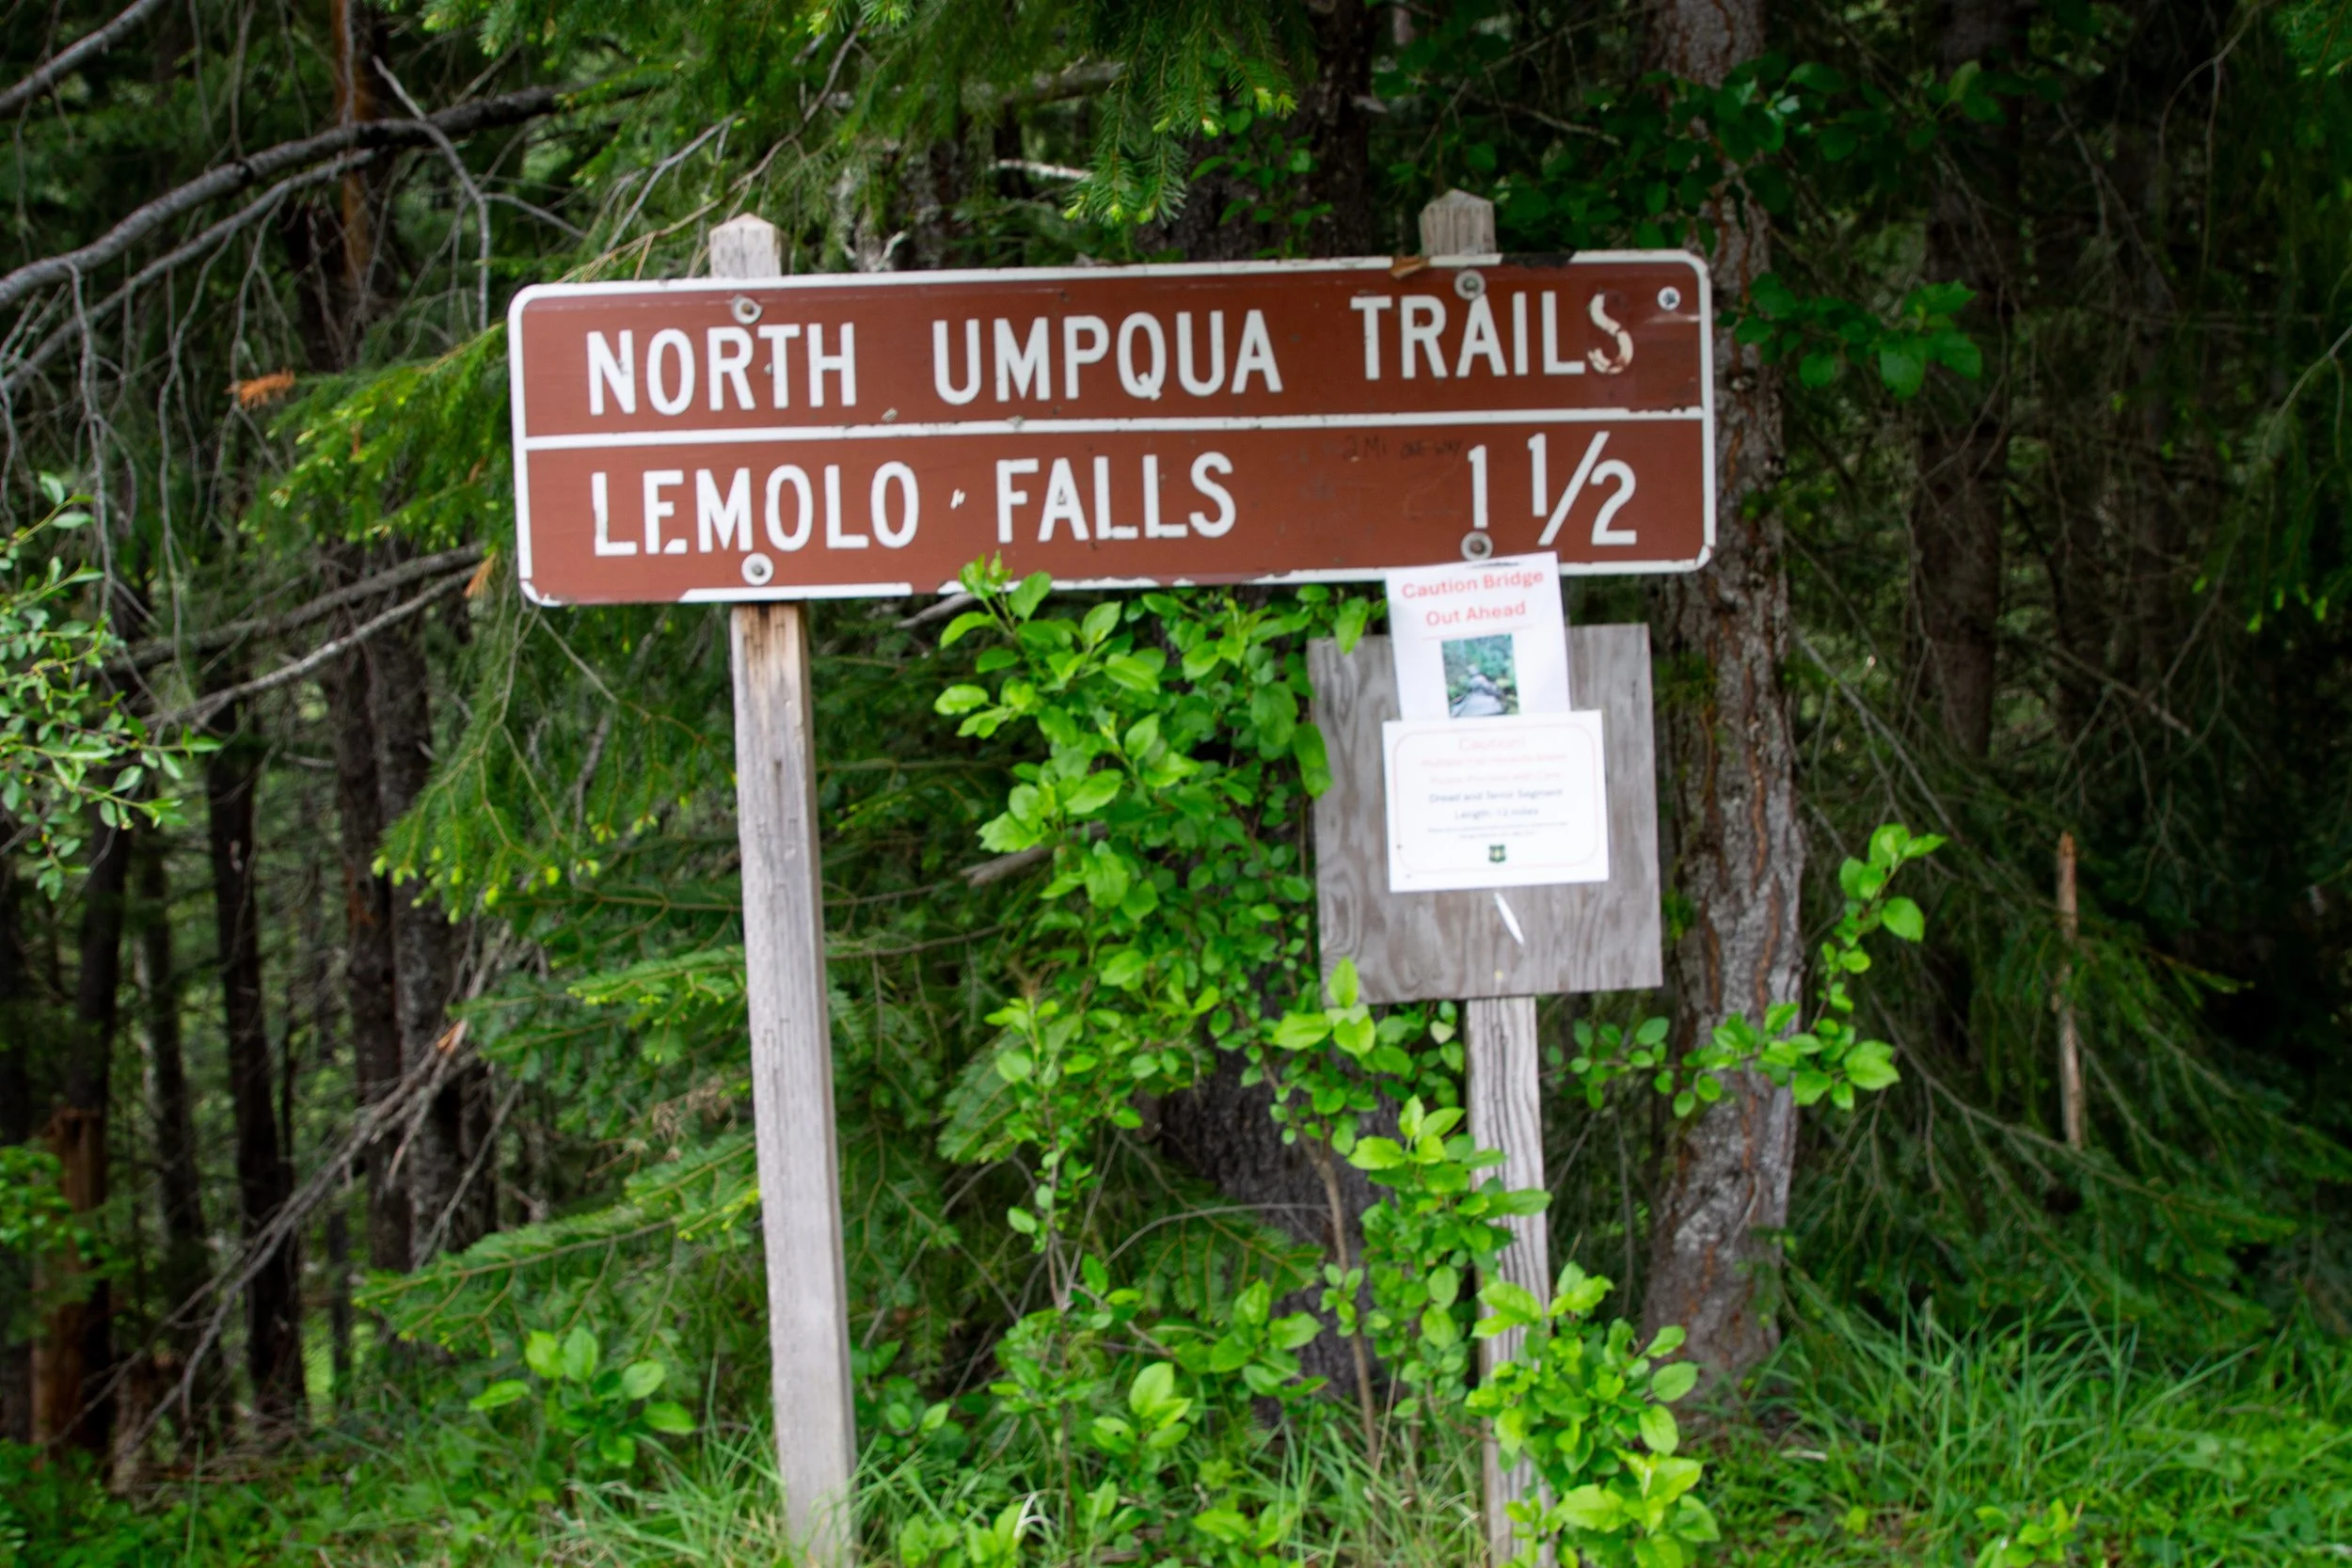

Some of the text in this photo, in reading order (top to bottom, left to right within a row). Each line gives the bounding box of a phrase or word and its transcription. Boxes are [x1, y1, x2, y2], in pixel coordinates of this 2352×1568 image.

[585, 291, 1633, 417] NORTH UMPQUA TRAILS
[591, 460, 920, 558] LEMOLO
[995, 451, 1236, 544] FALLS
[1468, 445, 1488, 529] 1
[1402, 570, 1545, 599] Caution Bridge
[1425, 601, 1527, 626] Out Ahead
[1463, 791, 1483, 800] and
[1517, 788, 1564, 800] Segment
